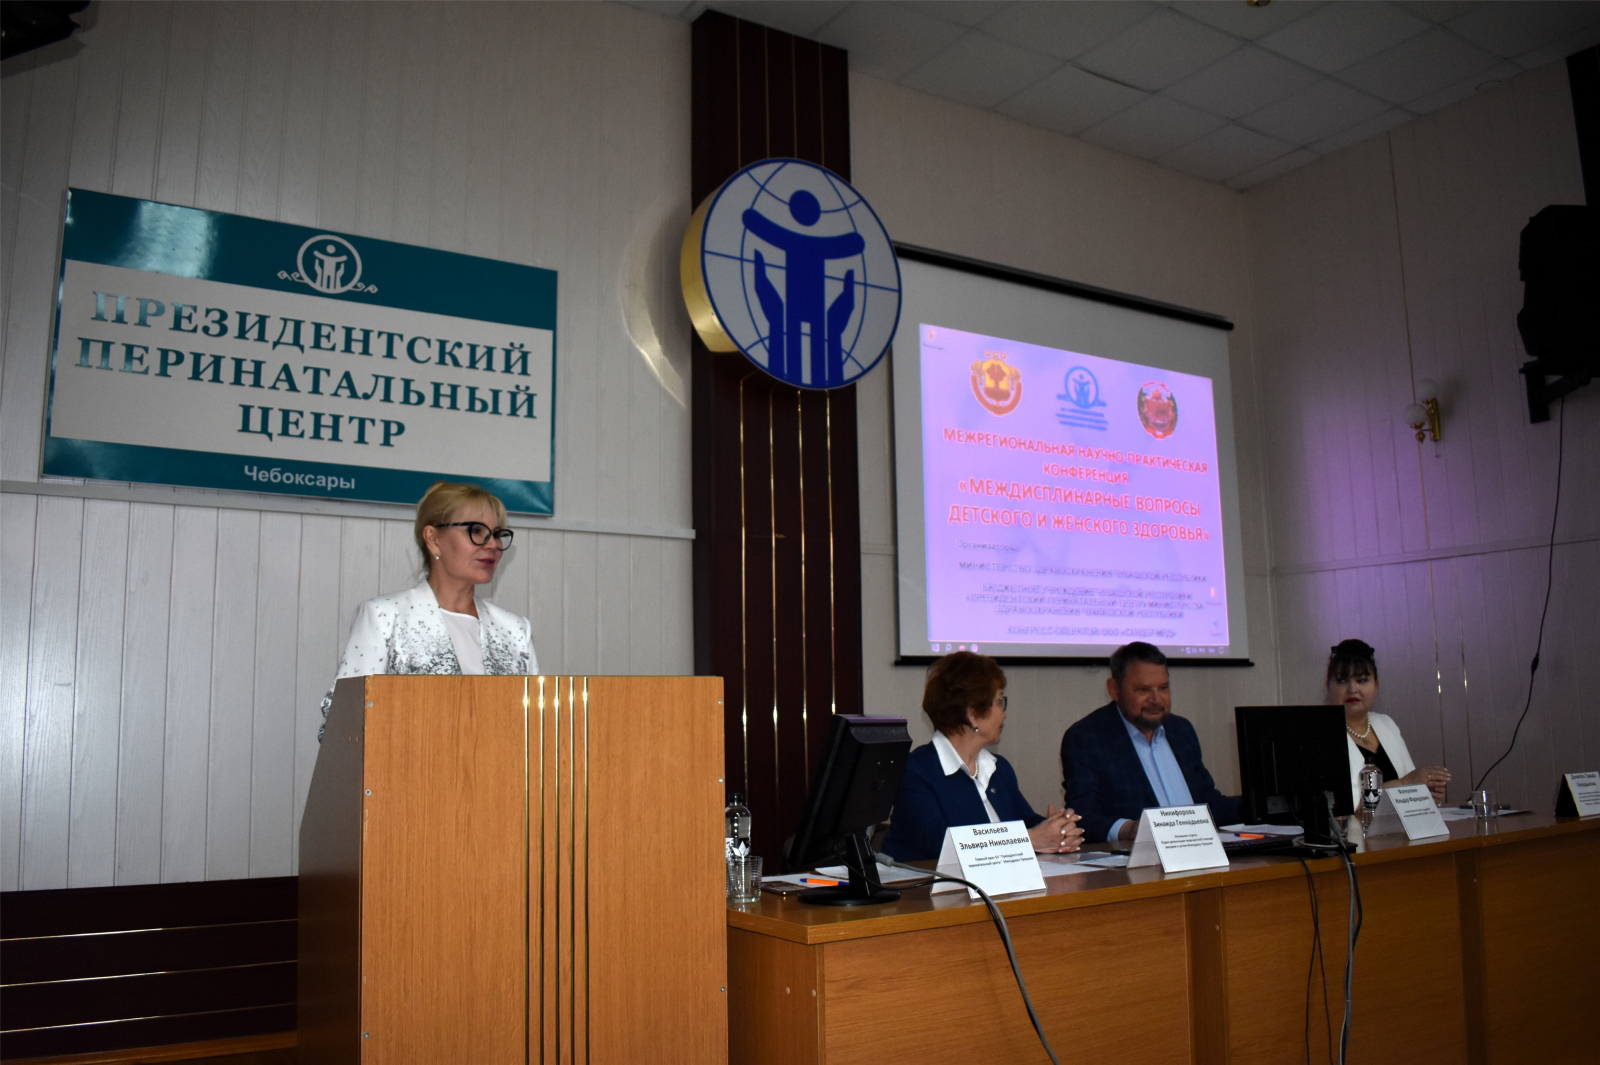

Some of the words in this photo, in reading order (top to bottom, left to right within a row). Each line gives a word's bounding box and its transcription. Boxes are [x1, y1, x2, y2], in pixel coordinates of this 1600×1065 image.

[91, 290, 532, 377] ПРЕЗИДЕНТСКИЙ
[75, 336, 538, 419] ПЕРИНАТАЛЬНЫЙ
[237, 403, 406, 448] ЦЕНТР
[943, 428, 1075, 458] МЕЖРЕГИОНАЛЬНАЯ
[1077, 446, 1208, 474] НАУЧНО-ПРАКТИЧЕСКАЯ
[243, 465, 355, 490] Чебоксары
[1043, 462, 1129, 486] КОНФЕРЕНЦИЯ
[1135, 495, 1201, 517] ВОПРОСЫ
[948, 504, 1032, 528] ДЕТСКОГО
[1037, 512, 1047, 529] И
[1051, 513, 1129, 536] ЖЕНСКОГО
[1132, 521, 1210, 542] ЗДОРОВЬЯ»
[1160, 809, 1195, 817] Никифорова
[1176, 818, 1209, 827] Геннадьевна
[959, 841, 988, 850] Эльвира
[989, 836, 1030, 847] Николаевна
[972, 826, 1008, 836] Васильева
